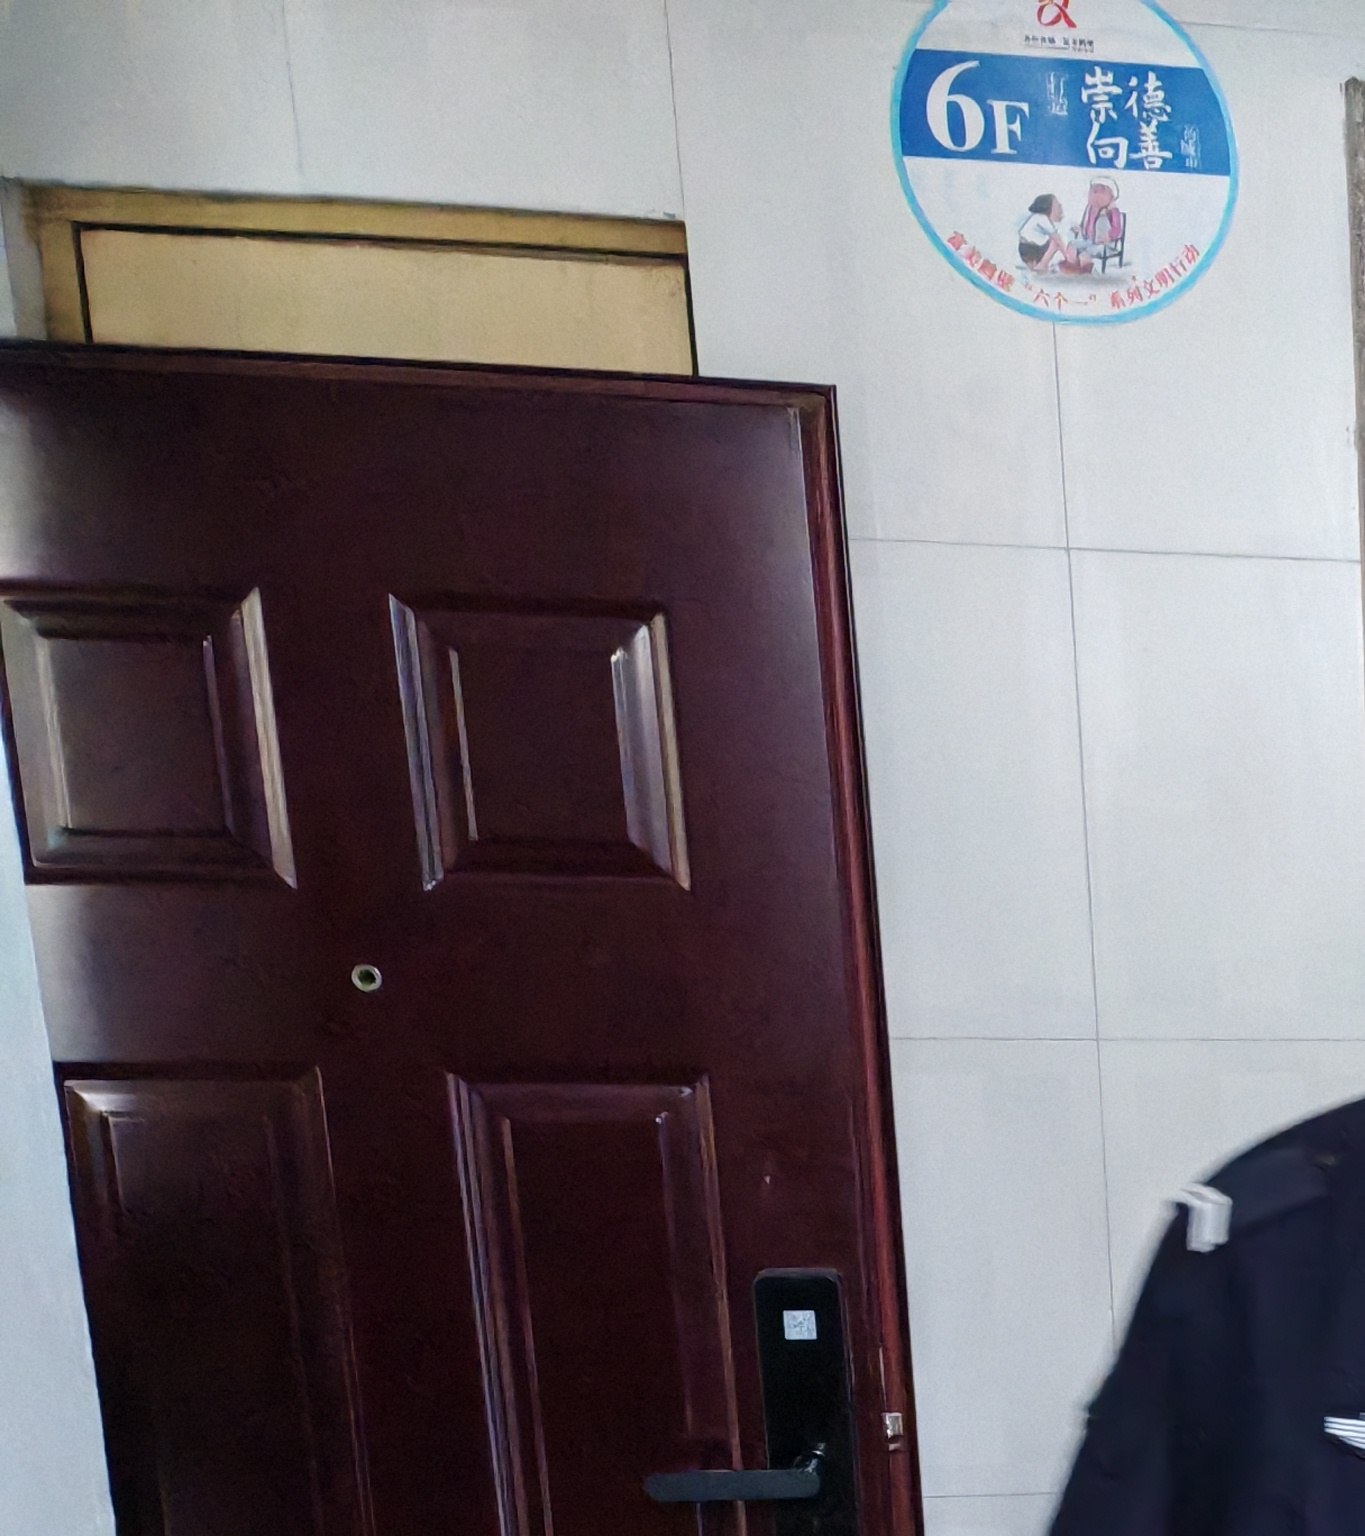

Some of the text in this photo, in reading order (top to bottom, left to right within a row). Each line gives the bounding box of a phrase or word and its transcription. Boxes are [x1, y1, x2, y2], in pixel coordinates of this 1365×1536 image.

[925, 60, 1030, 155] 6F
[1080, 65, 1173, 125] 崇德
[1085, 118, 1174, 170] 向善
